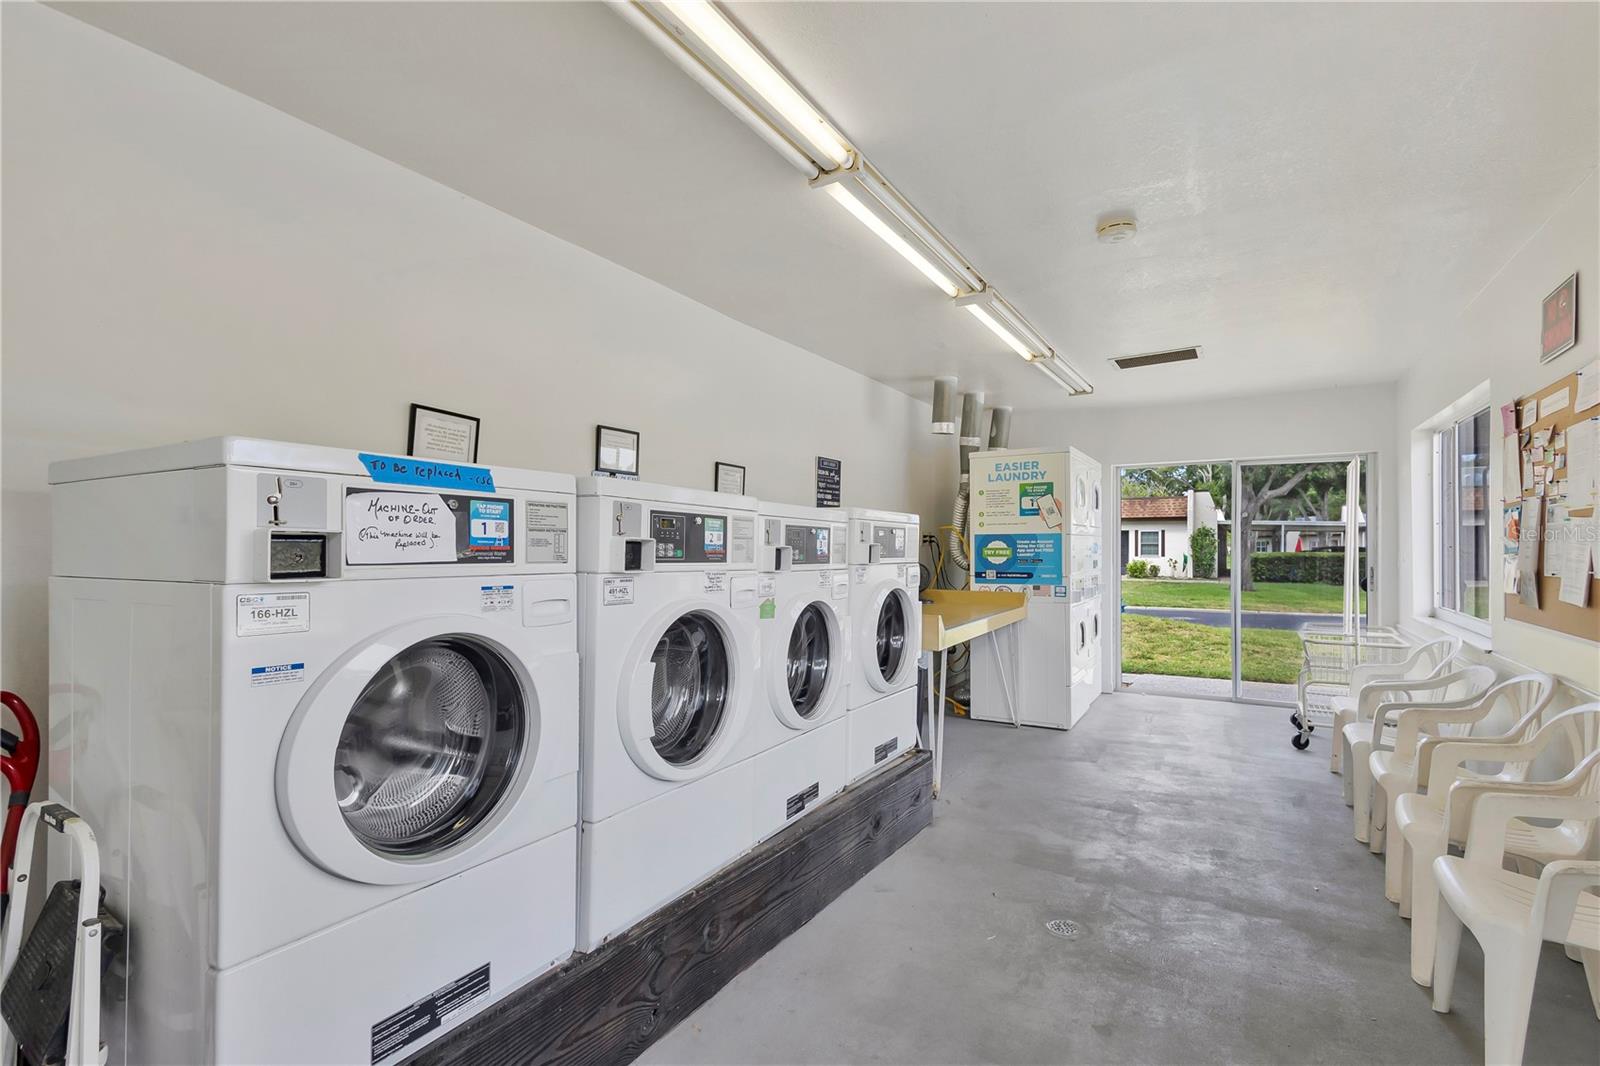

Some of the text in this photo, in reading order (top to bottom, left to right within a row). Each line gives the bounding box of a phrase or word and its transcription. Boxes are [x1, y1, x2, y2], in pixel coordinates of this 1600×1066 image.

[995, 461, 1040, 472] EASIER
[415, 465, 462, 481] replaced
[988, 470, 1047, 482] LAUNDRY
[482, 522, 487, 535] 1
[709, 533, 714, 542] 2
[250, 608, 298, 619] 166-HZL
[265, 664, 292, 672] NOTICE
